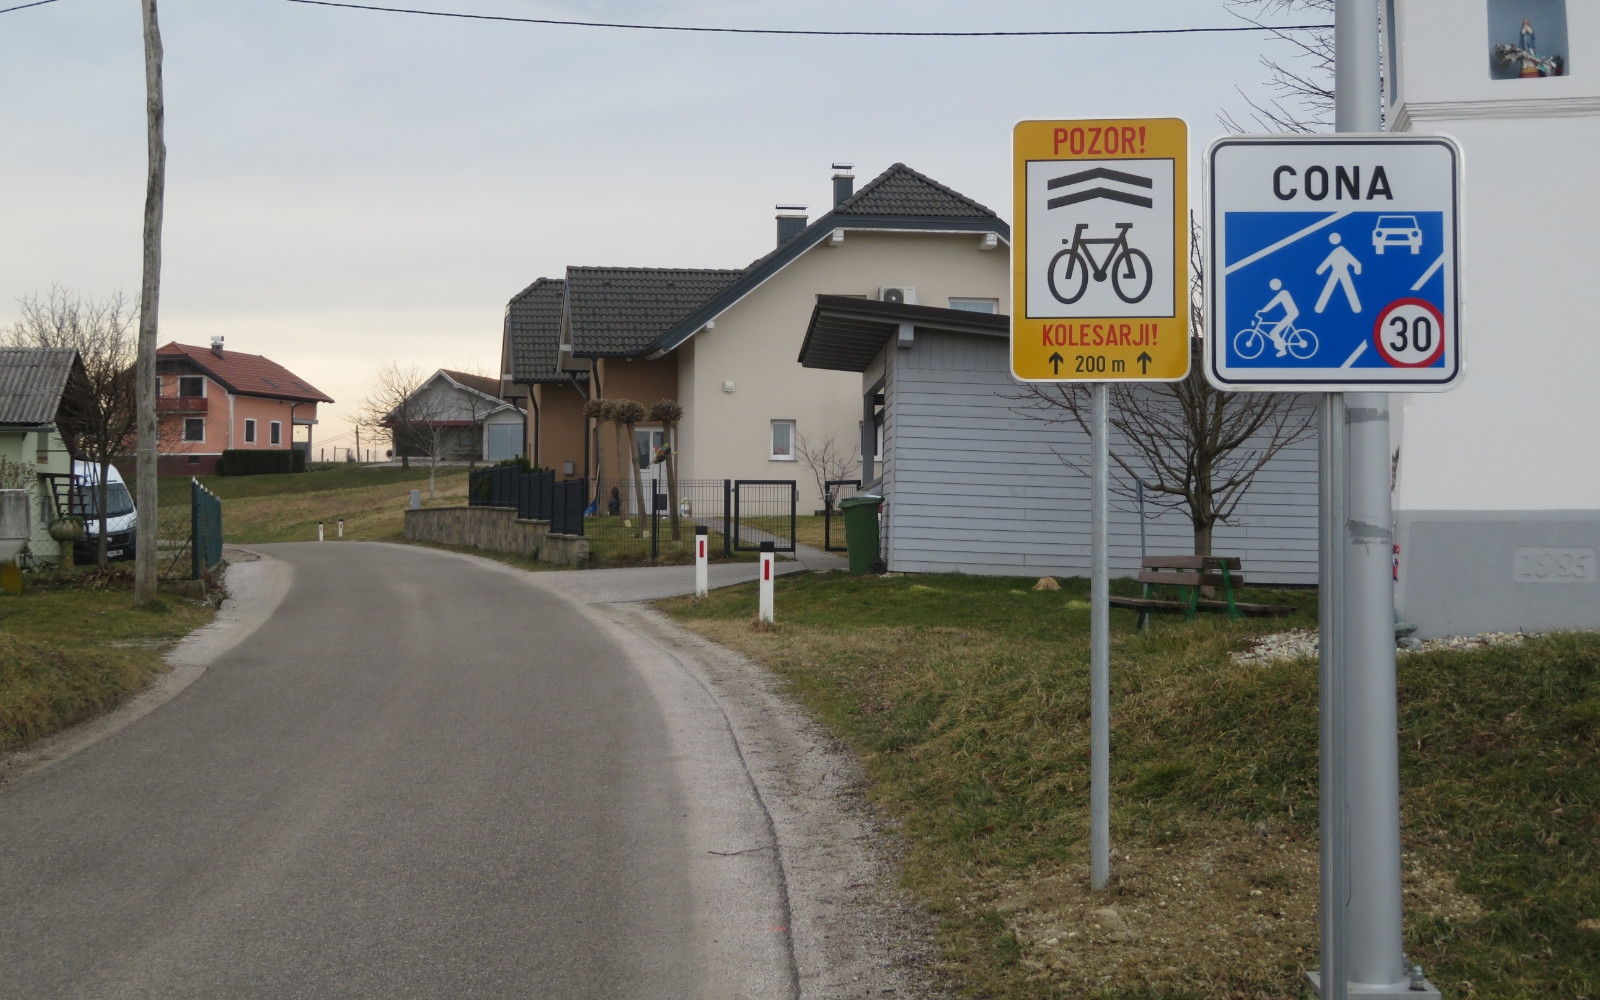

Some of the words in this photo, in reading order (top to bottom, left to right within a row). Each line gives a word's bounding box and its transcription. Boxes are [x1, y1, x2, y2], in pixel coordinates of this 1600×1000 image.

[1054, 126, 1146, 155] POZOR!
[1273, 165, 1394, 200] CONA
[1042, 323, 1158, 347] KOLESARJI!
[1389, 316, 1432, 352] 30
[1075, 355, 1106, 373] 200
[1111, 359, 1126, 373] m
[1519, 553, 1591, 579] 1985
